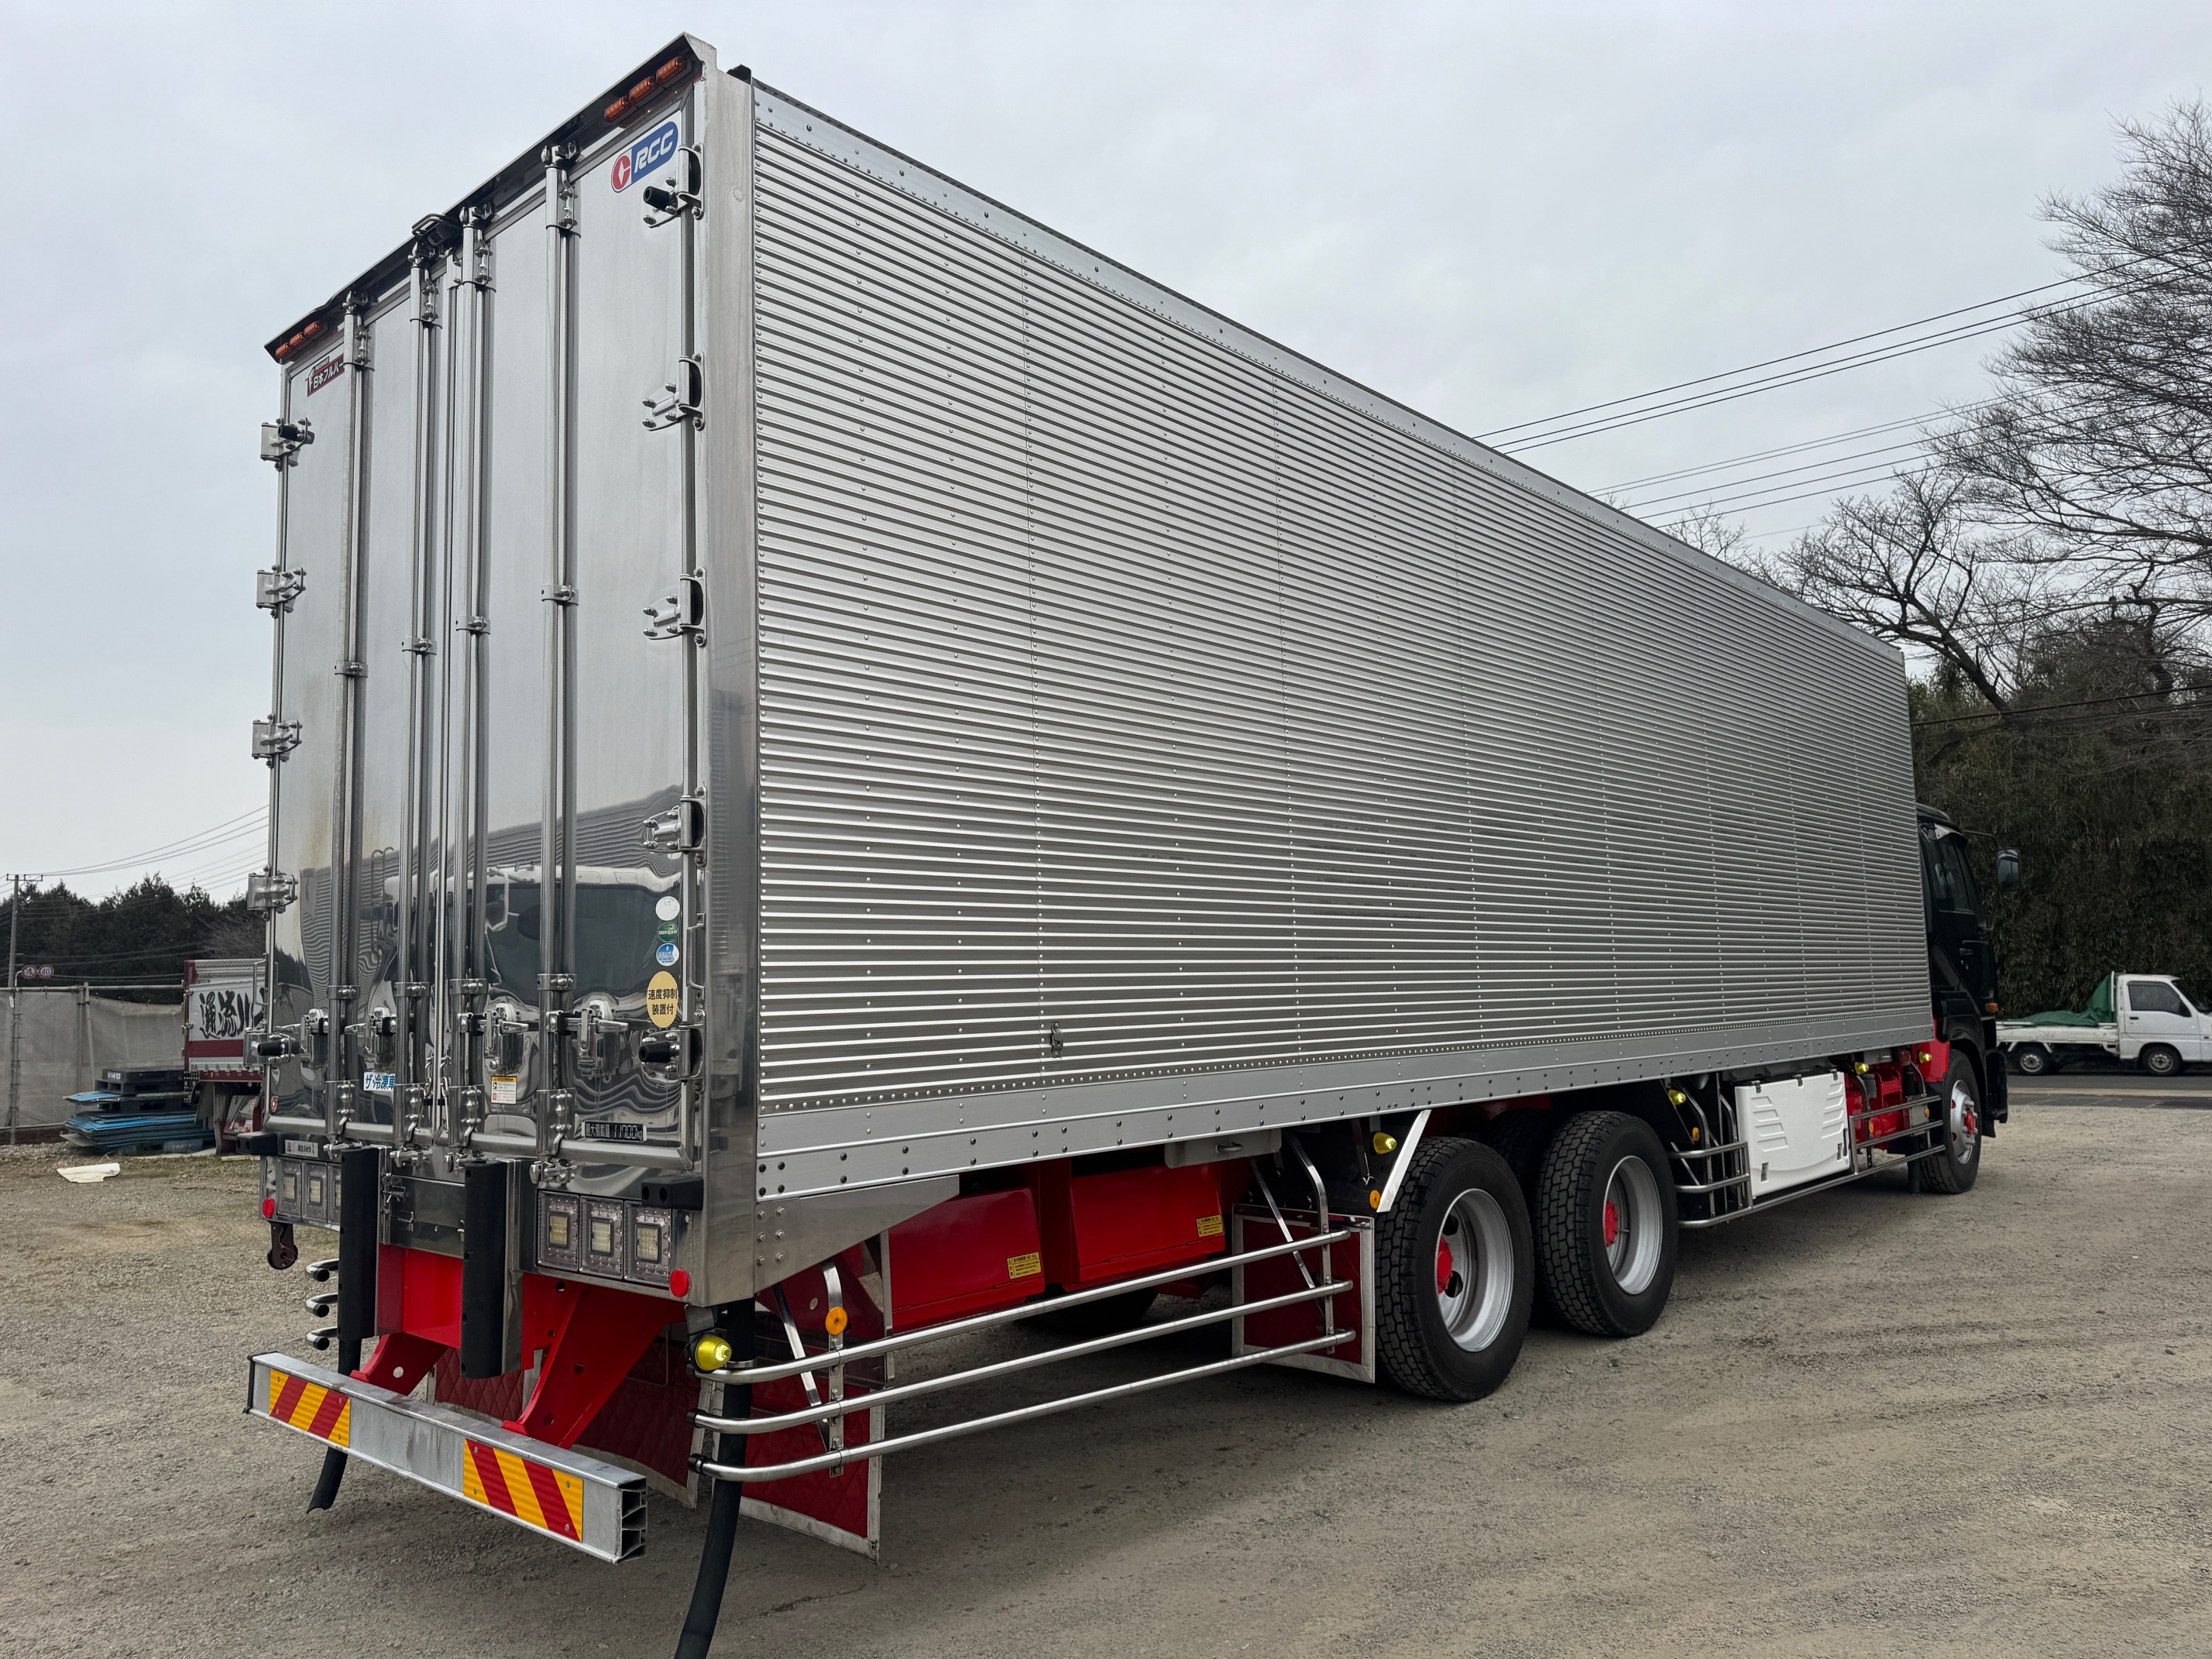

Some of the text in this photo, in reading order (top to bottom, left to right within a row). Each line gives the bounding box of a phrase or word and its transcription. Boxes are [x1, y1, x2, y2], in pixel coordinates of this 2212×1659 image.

[647, 988, 678, 1000] 速度抑制
[651, 1003, 675, 1015] 装置付
